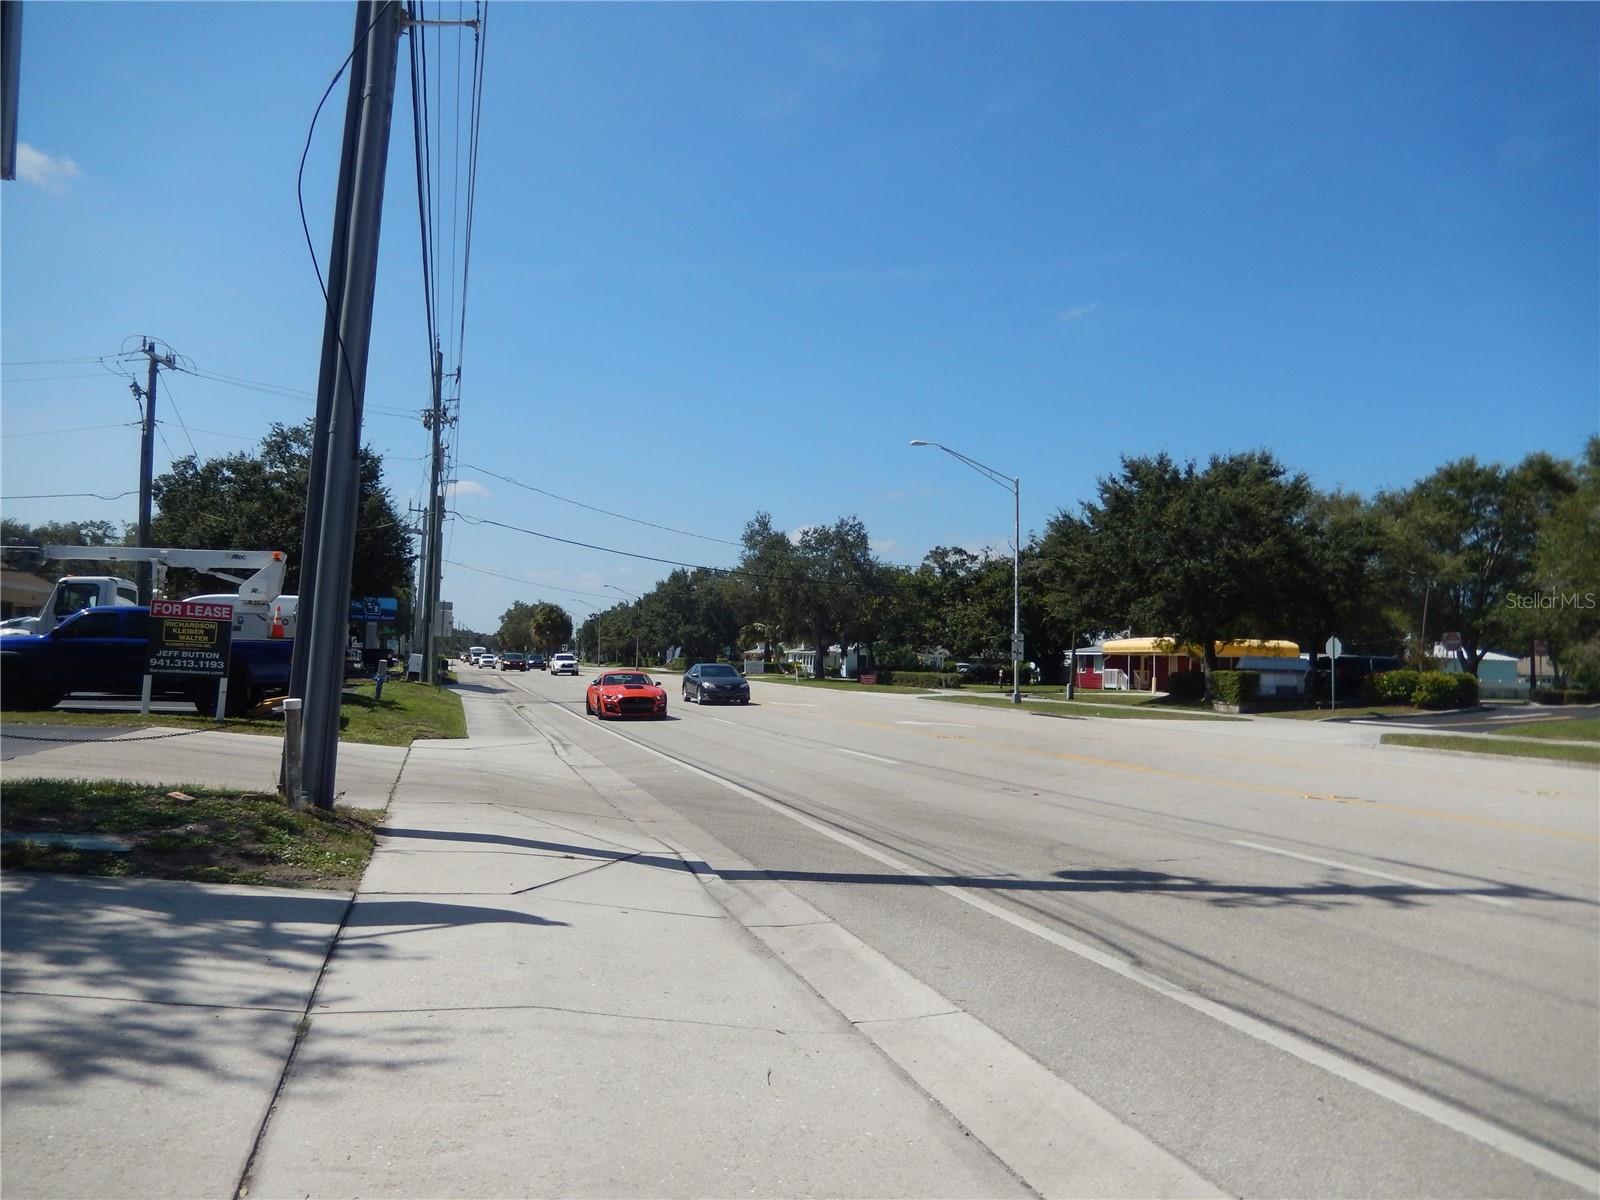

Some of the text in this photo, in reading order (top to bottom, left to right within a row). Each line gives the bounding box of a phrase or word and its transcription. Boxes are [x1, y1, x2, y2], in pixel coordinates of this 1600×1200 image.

[153, 603, 231, 617] FOR LEASE
[166, 621, 216, 629] RICHARDSON
[182, 651, 220, 659] BUTTON
[149, 658, 225, 669] 941.313.1193
